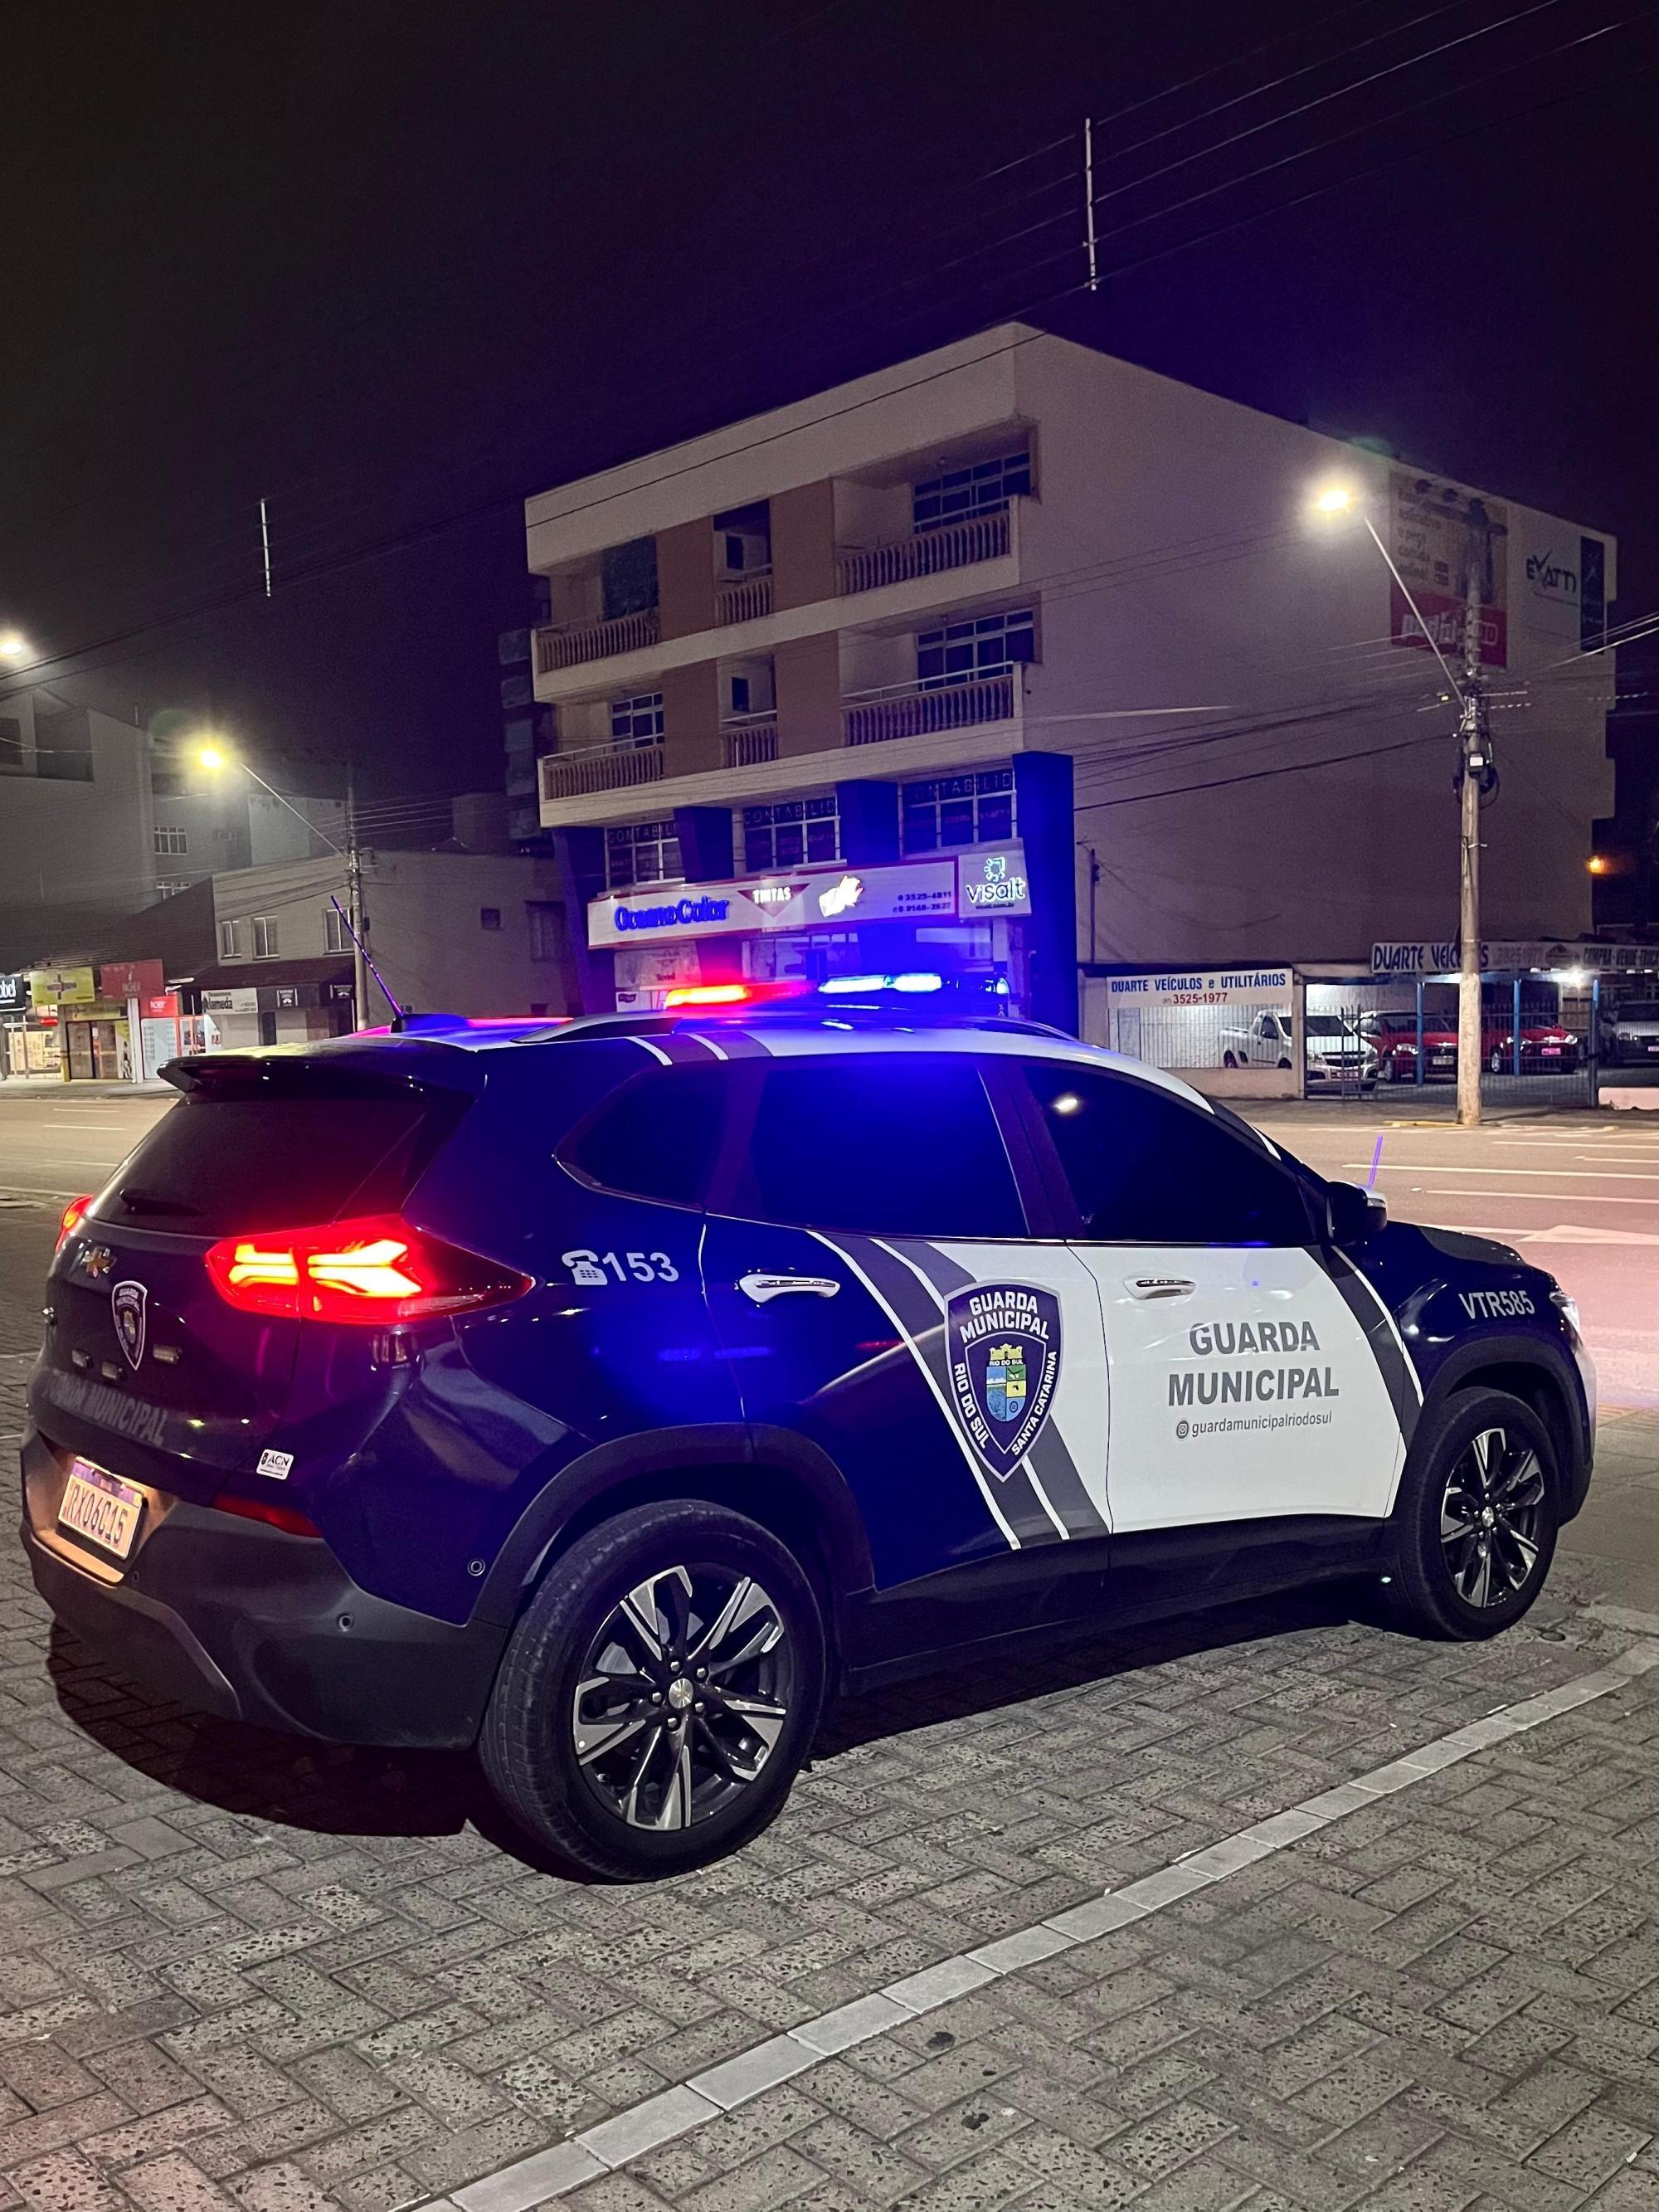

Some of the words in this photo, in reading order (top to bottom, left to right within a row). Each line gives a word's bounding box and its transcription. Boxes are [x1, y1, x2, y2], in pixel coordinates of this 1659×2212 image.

[752, 886, 791, 904] TINTAS
[966, 877, 1026, 904] visalt
[1373, 944, 1423, 970] DUARTE
[1112, 979, 1149, 992] DUARTE
[1155, 975, 1202, 992] VEÍCULOS
[1209, 981, 1214, 989] e
[1221, 972, 1286, 988] UTILITÁRIOS
[1173, 992, 1228, 1005] 3525-1977
[602, 1252, 679, 1282] 153
[969, 1291, 1039, 1316] GUARDA
[1458, 1290, 1535, 1319] VTR585
[960, 1311, 1049, 1343] MUNICIPAL
[1190, 1321, 1321, 1356] GUARDA
[954, 1362, 970, 1393] RIO
[1169, 1367, 1340, 1406] MUNICIPAL
[961, 1393, 977, 1418] DO
[1011, 1416, 1039, 1455] SANTA
[1034, 1351, 1058, 1416] CATARINA
[970, 1416, 990, 1449] SUL
[267, 1454, 289, 1466] ACN
